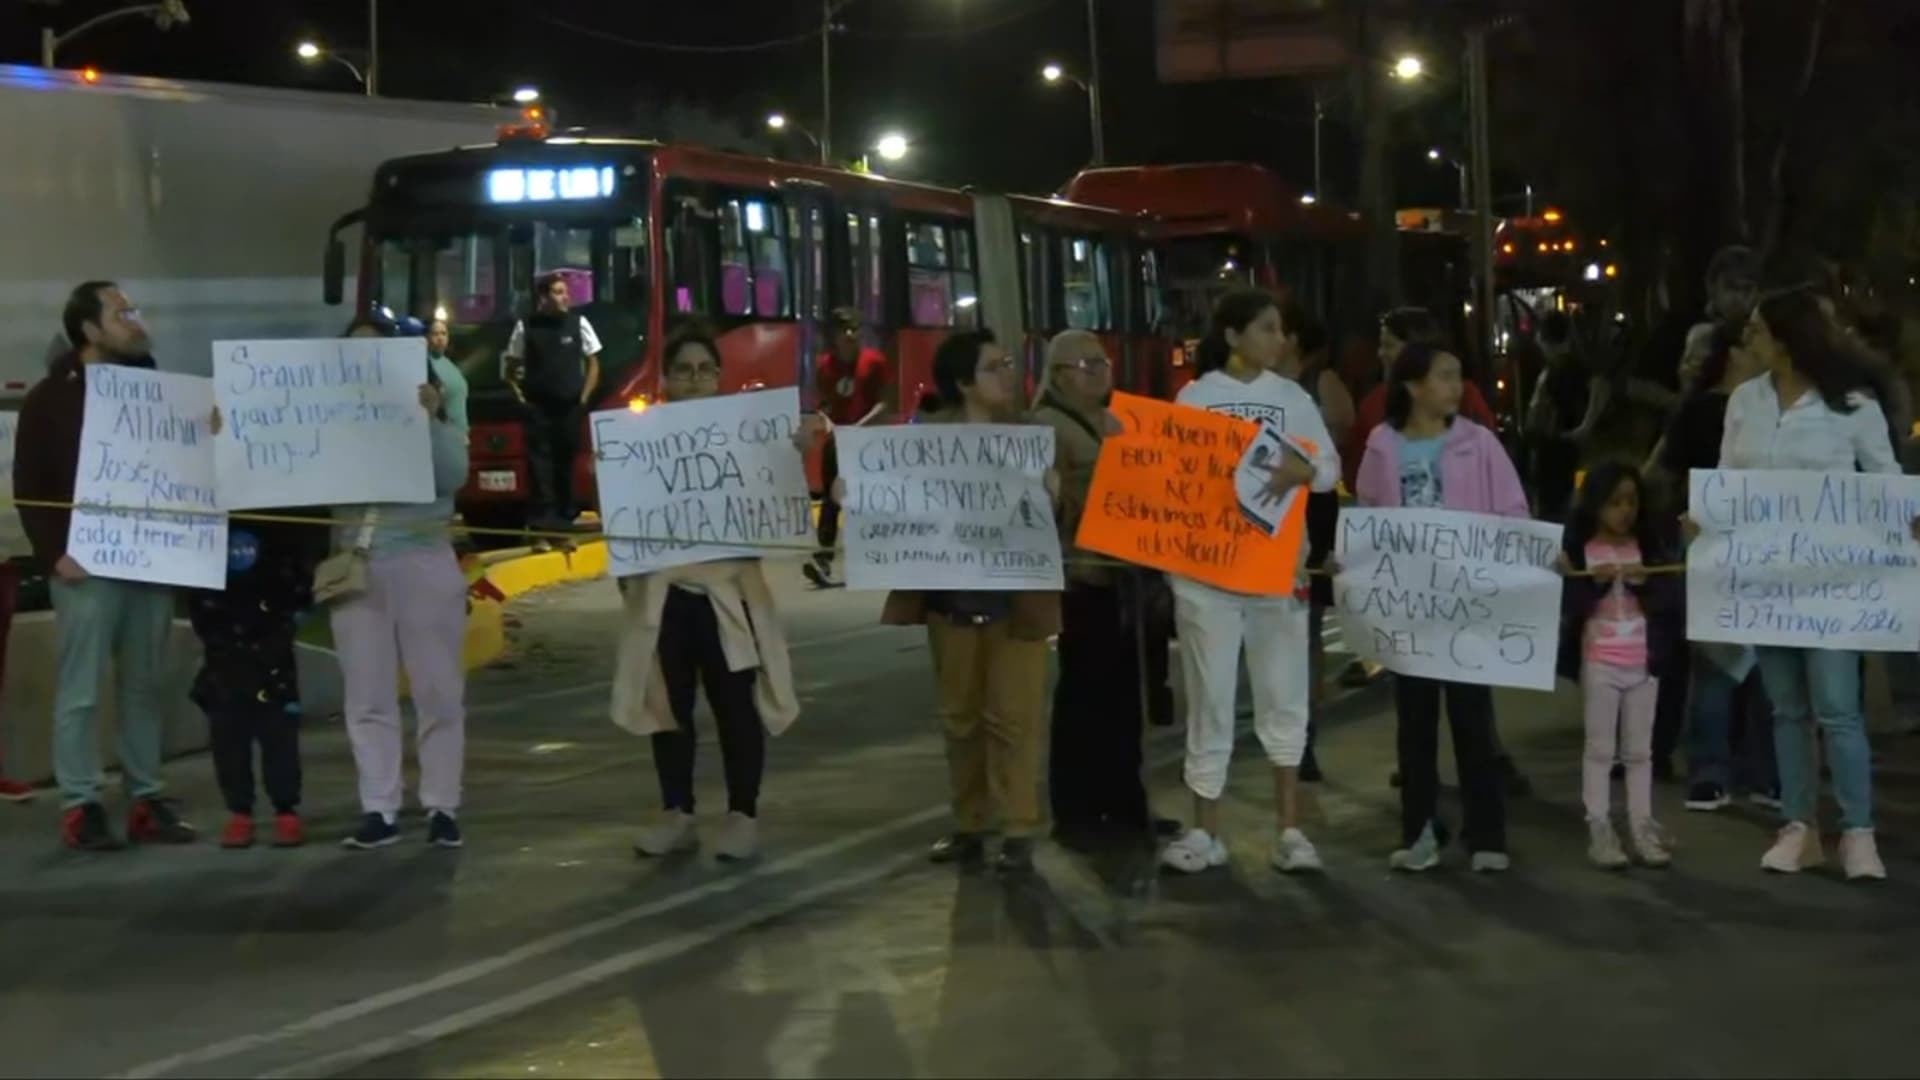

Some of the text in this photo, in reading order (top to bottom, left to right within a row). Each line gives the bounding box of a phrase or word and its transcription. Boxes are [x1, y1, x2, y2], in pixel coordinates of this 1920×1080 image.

[656, 450, 745, 494] VIDA
[1371, 552, 1500, 597] A LAS
